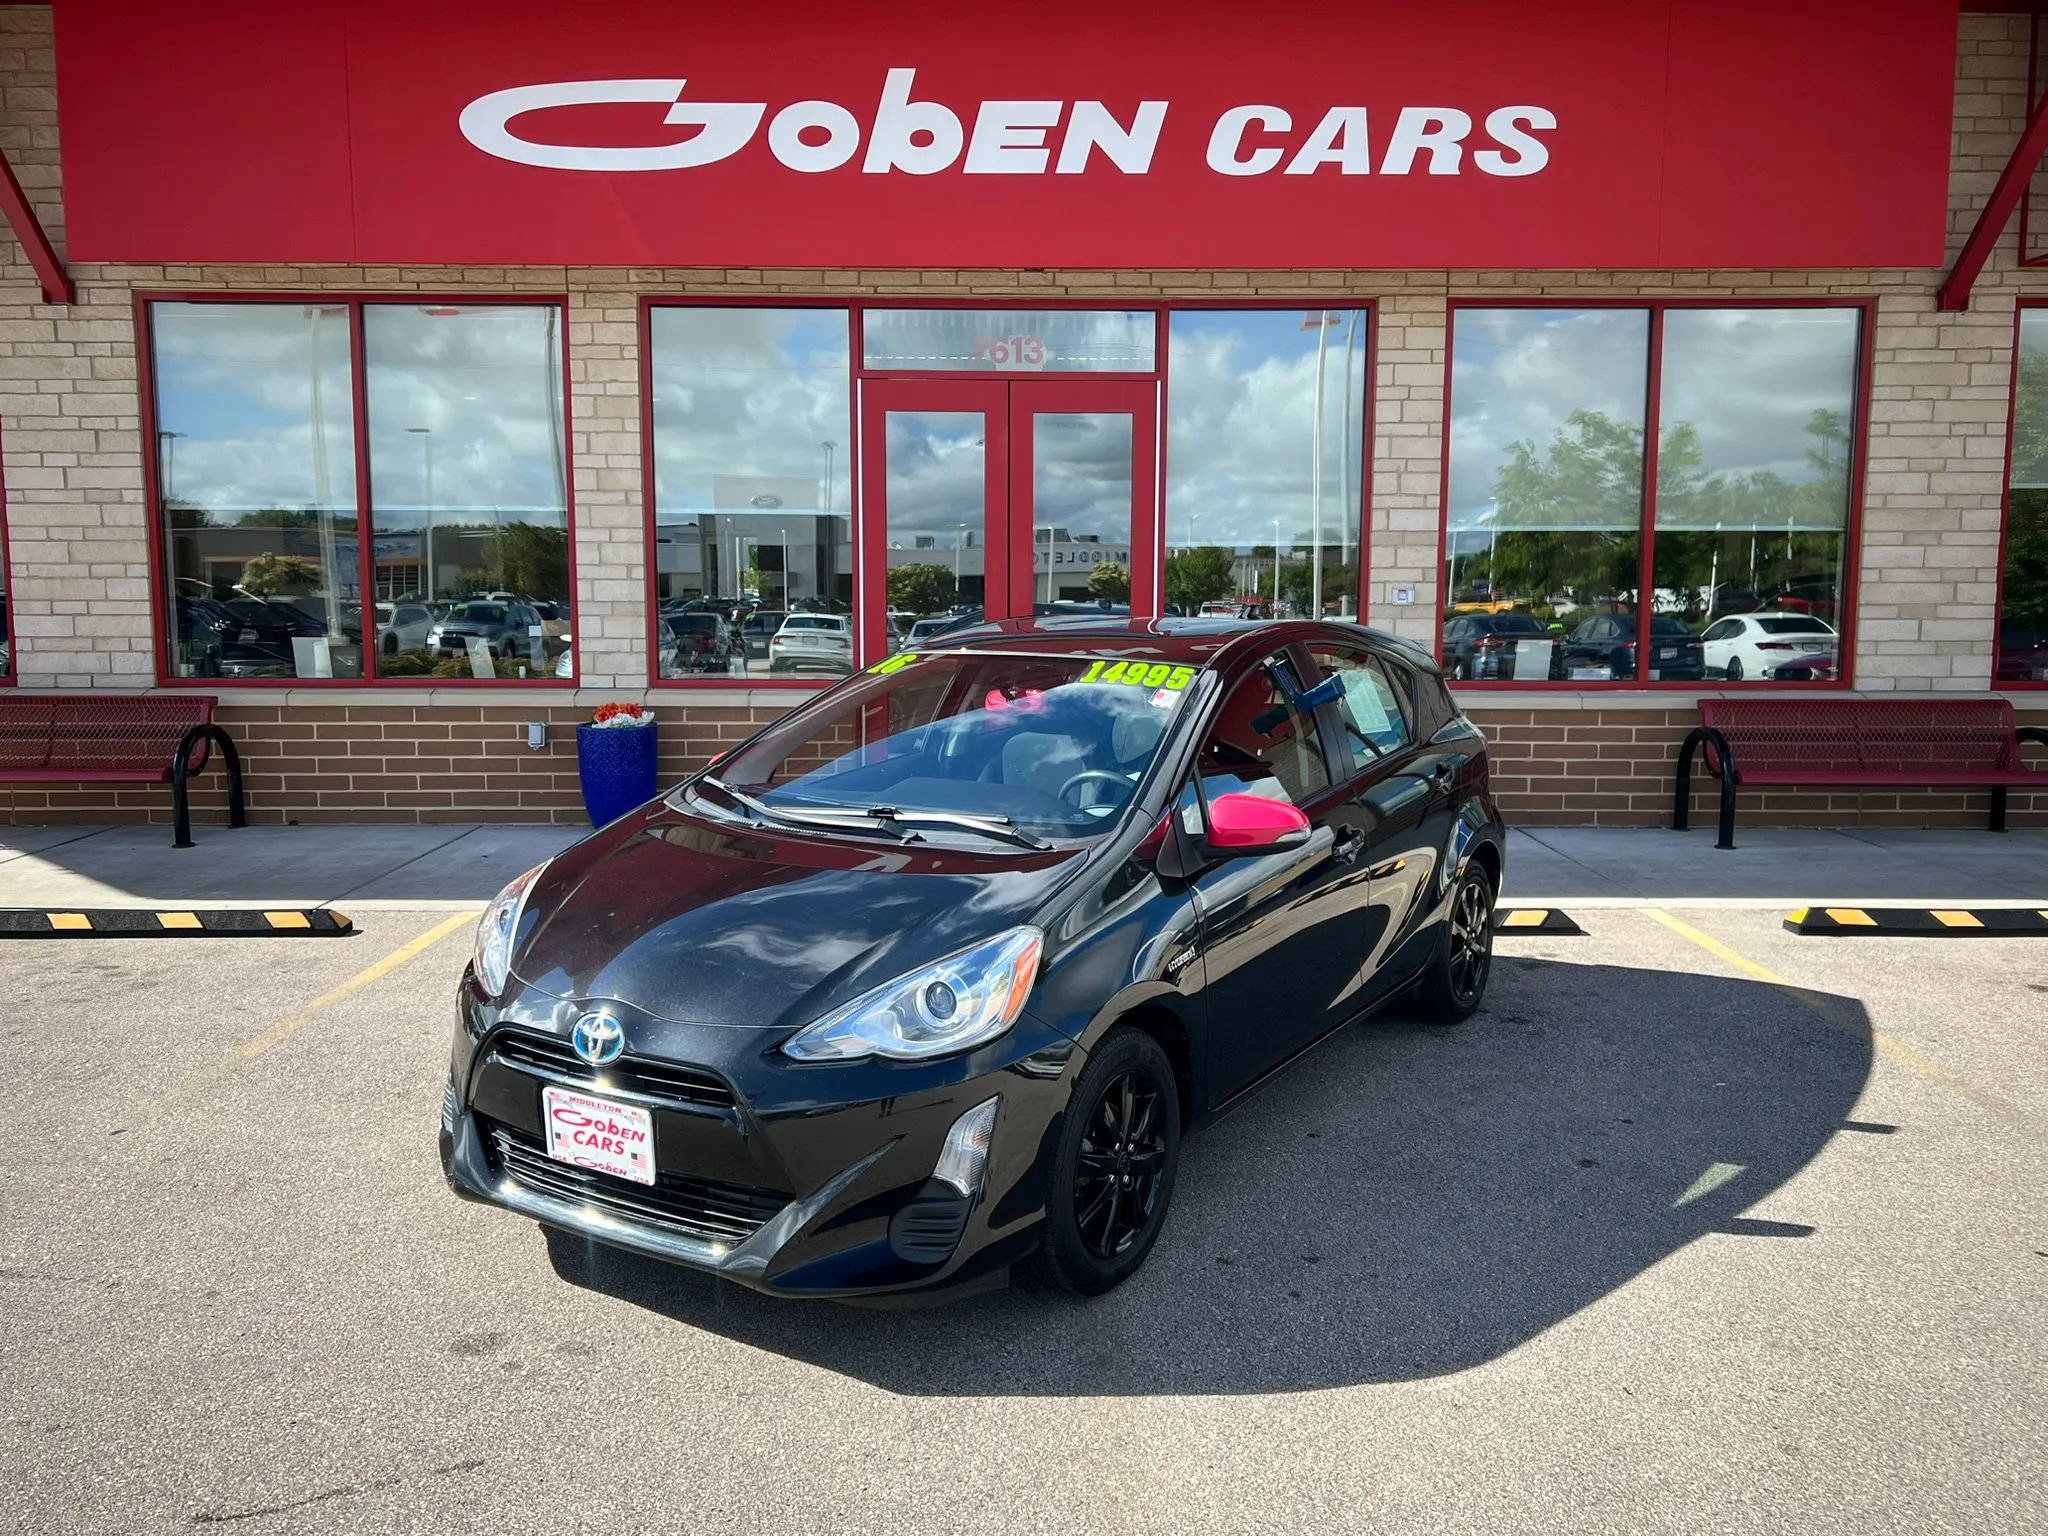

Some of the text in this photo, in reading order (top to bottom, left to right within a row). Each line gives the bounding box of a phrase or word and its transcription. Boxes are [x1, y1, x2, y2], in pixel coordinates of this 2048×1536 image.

[1207, 105, 1557, 177] CARS
[1080, 661, 1195, 690] 14995
[569, 1096, 622, 1114] MIDDLETON
[573, 1130, 625, 1155] CARS
